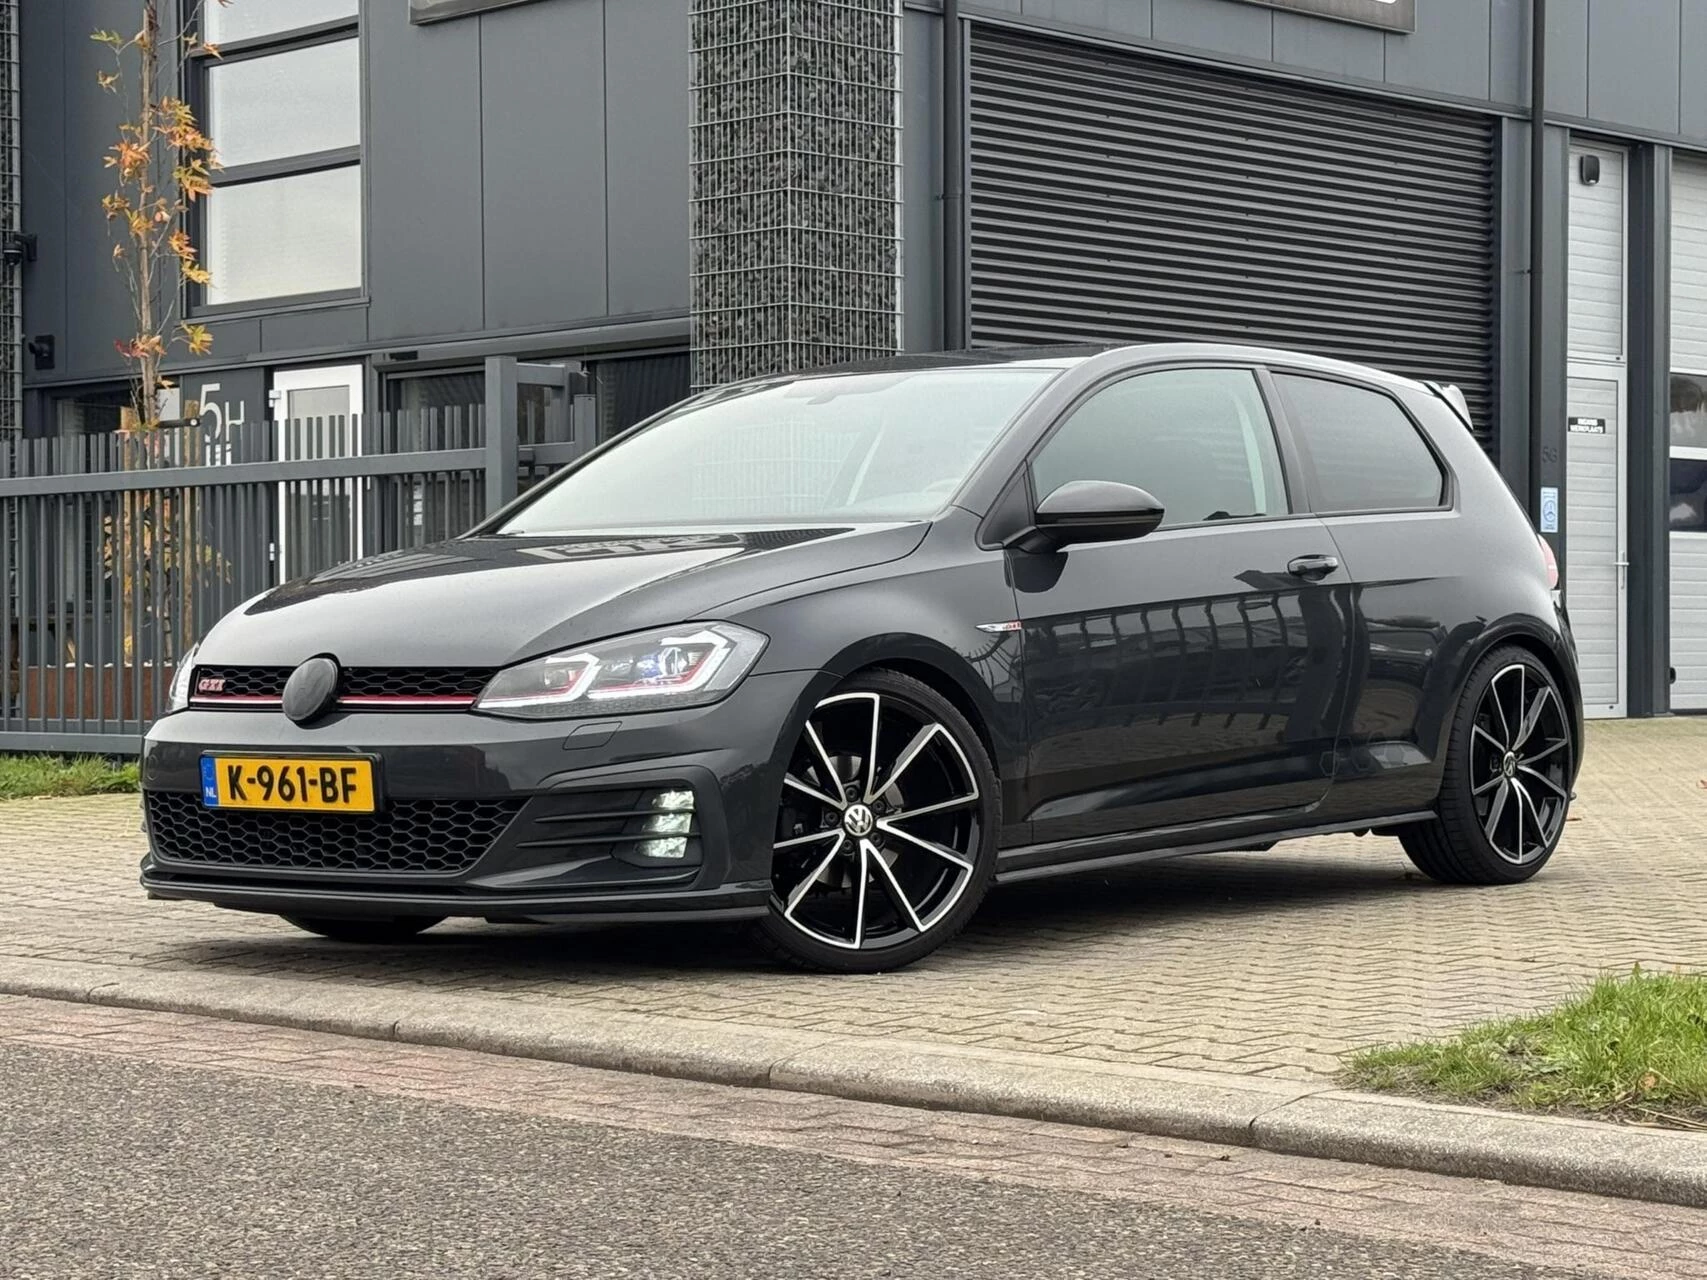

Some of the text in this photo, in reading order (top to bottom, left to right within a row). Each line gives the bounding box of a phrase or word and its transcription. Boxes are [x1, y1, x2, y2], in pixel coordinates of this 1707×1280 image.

[199, 383, 245, 442] 5H
[198, 679, 226, 692] GTI
[205, 787, 217, 798] NL
[227, 765, 357, 804] K-961-BF
